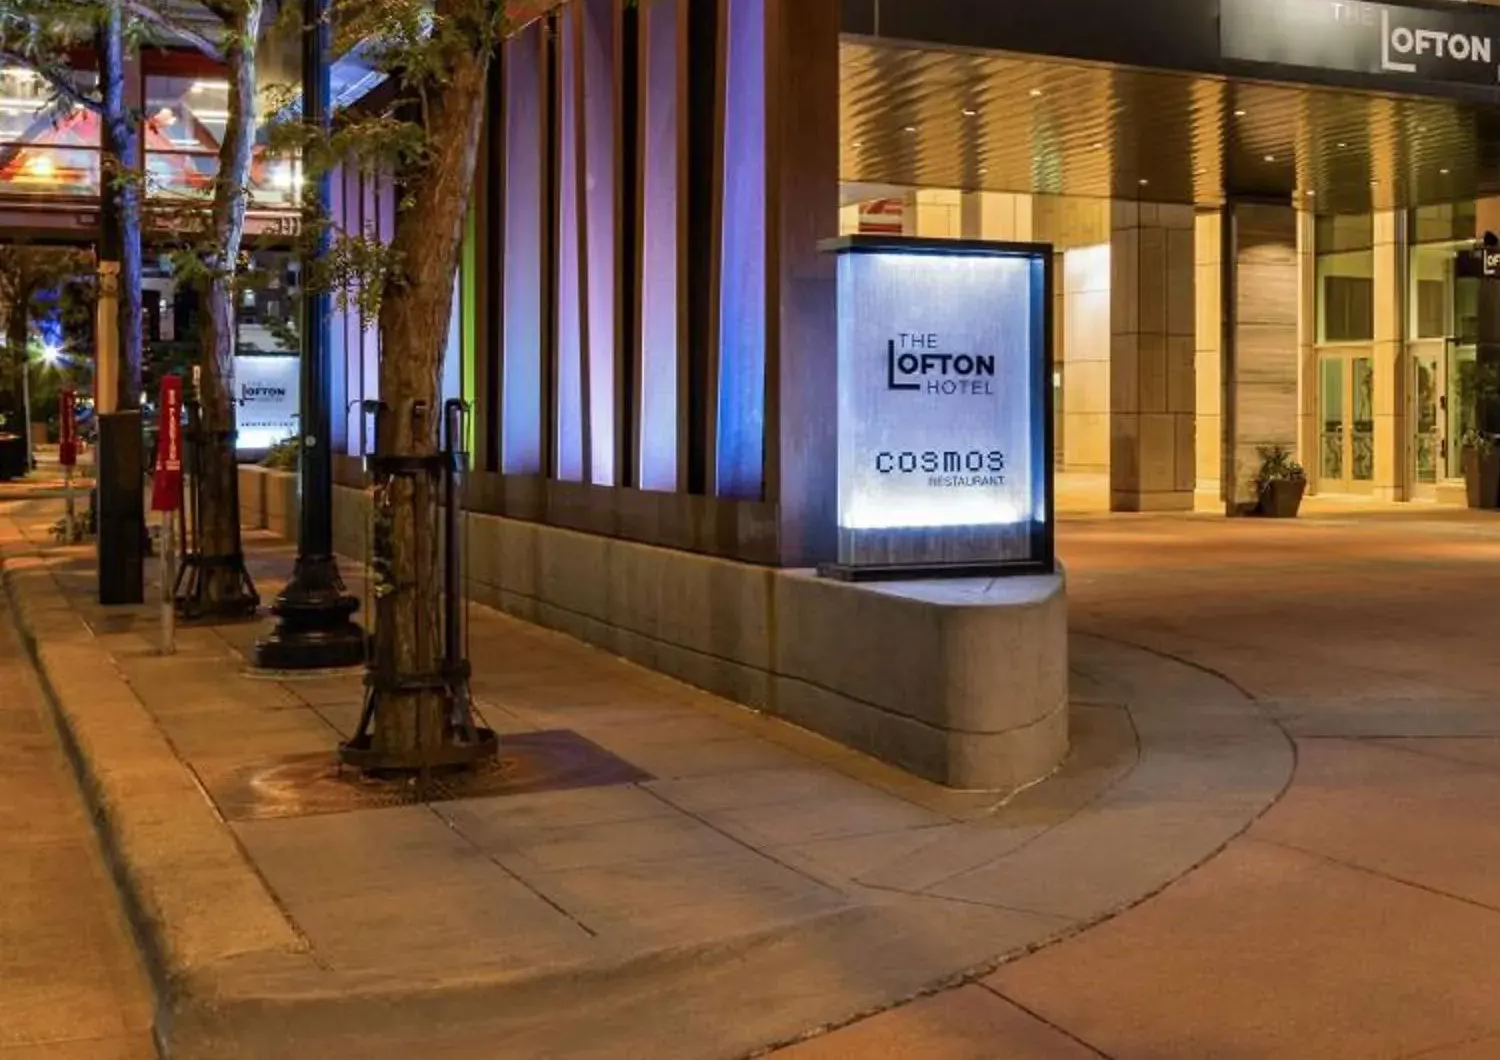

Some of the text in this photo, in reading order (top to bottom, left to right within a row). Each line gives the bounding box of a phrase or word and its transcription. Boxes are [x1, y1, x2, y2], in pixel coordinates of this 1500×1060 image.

[1381, 9, 1491, 73] LOFTON
[898, 333, 938, 349] THE
[887, 340, 995, 390] LOFTON
[927, 380, 994, 395] HOTEL
[875, 450, 1005, 474] COSMOS
[928, 475, 1006, 488] RESTAURANT
